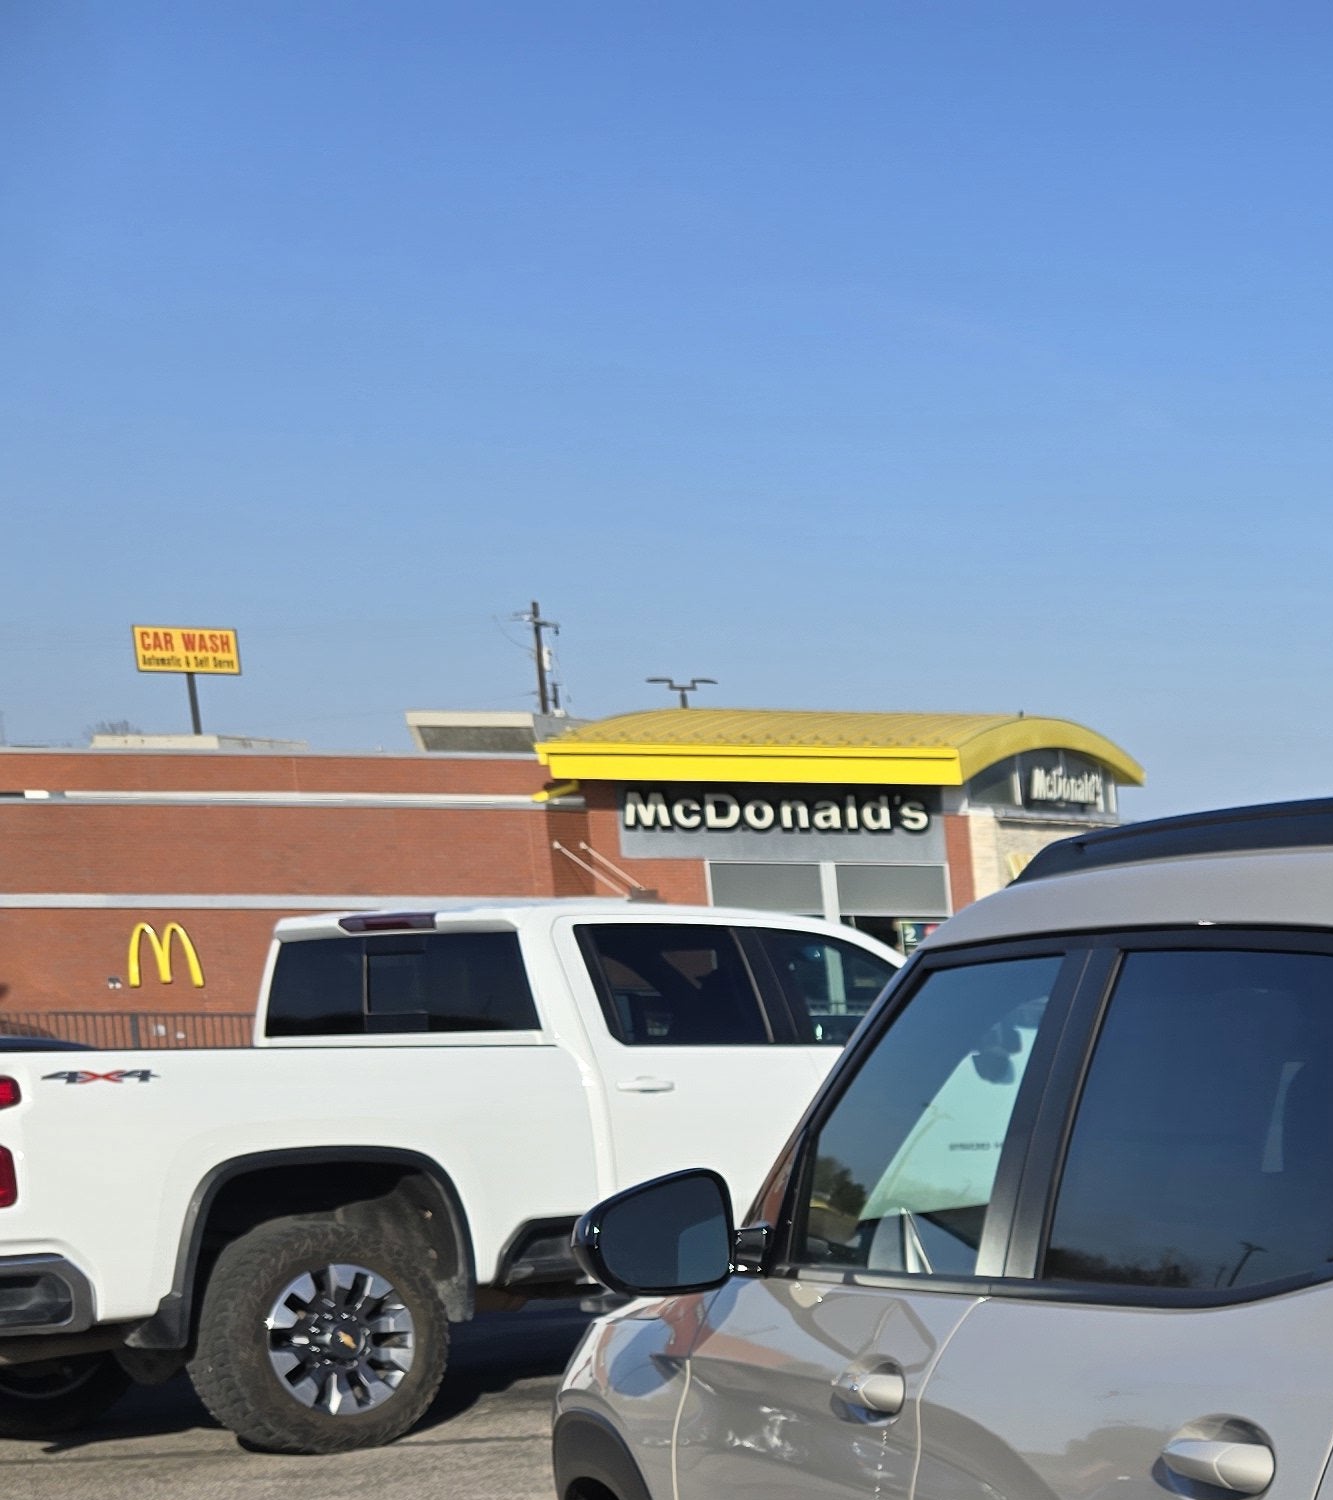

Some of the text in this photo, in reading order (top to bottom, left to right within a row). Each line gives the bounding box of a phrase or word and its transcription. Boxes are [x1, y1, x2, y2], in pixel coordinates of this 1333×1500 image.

[140, 631, 231, 653] CAR WASH
[624, 790, 930, 831] McDonald's
